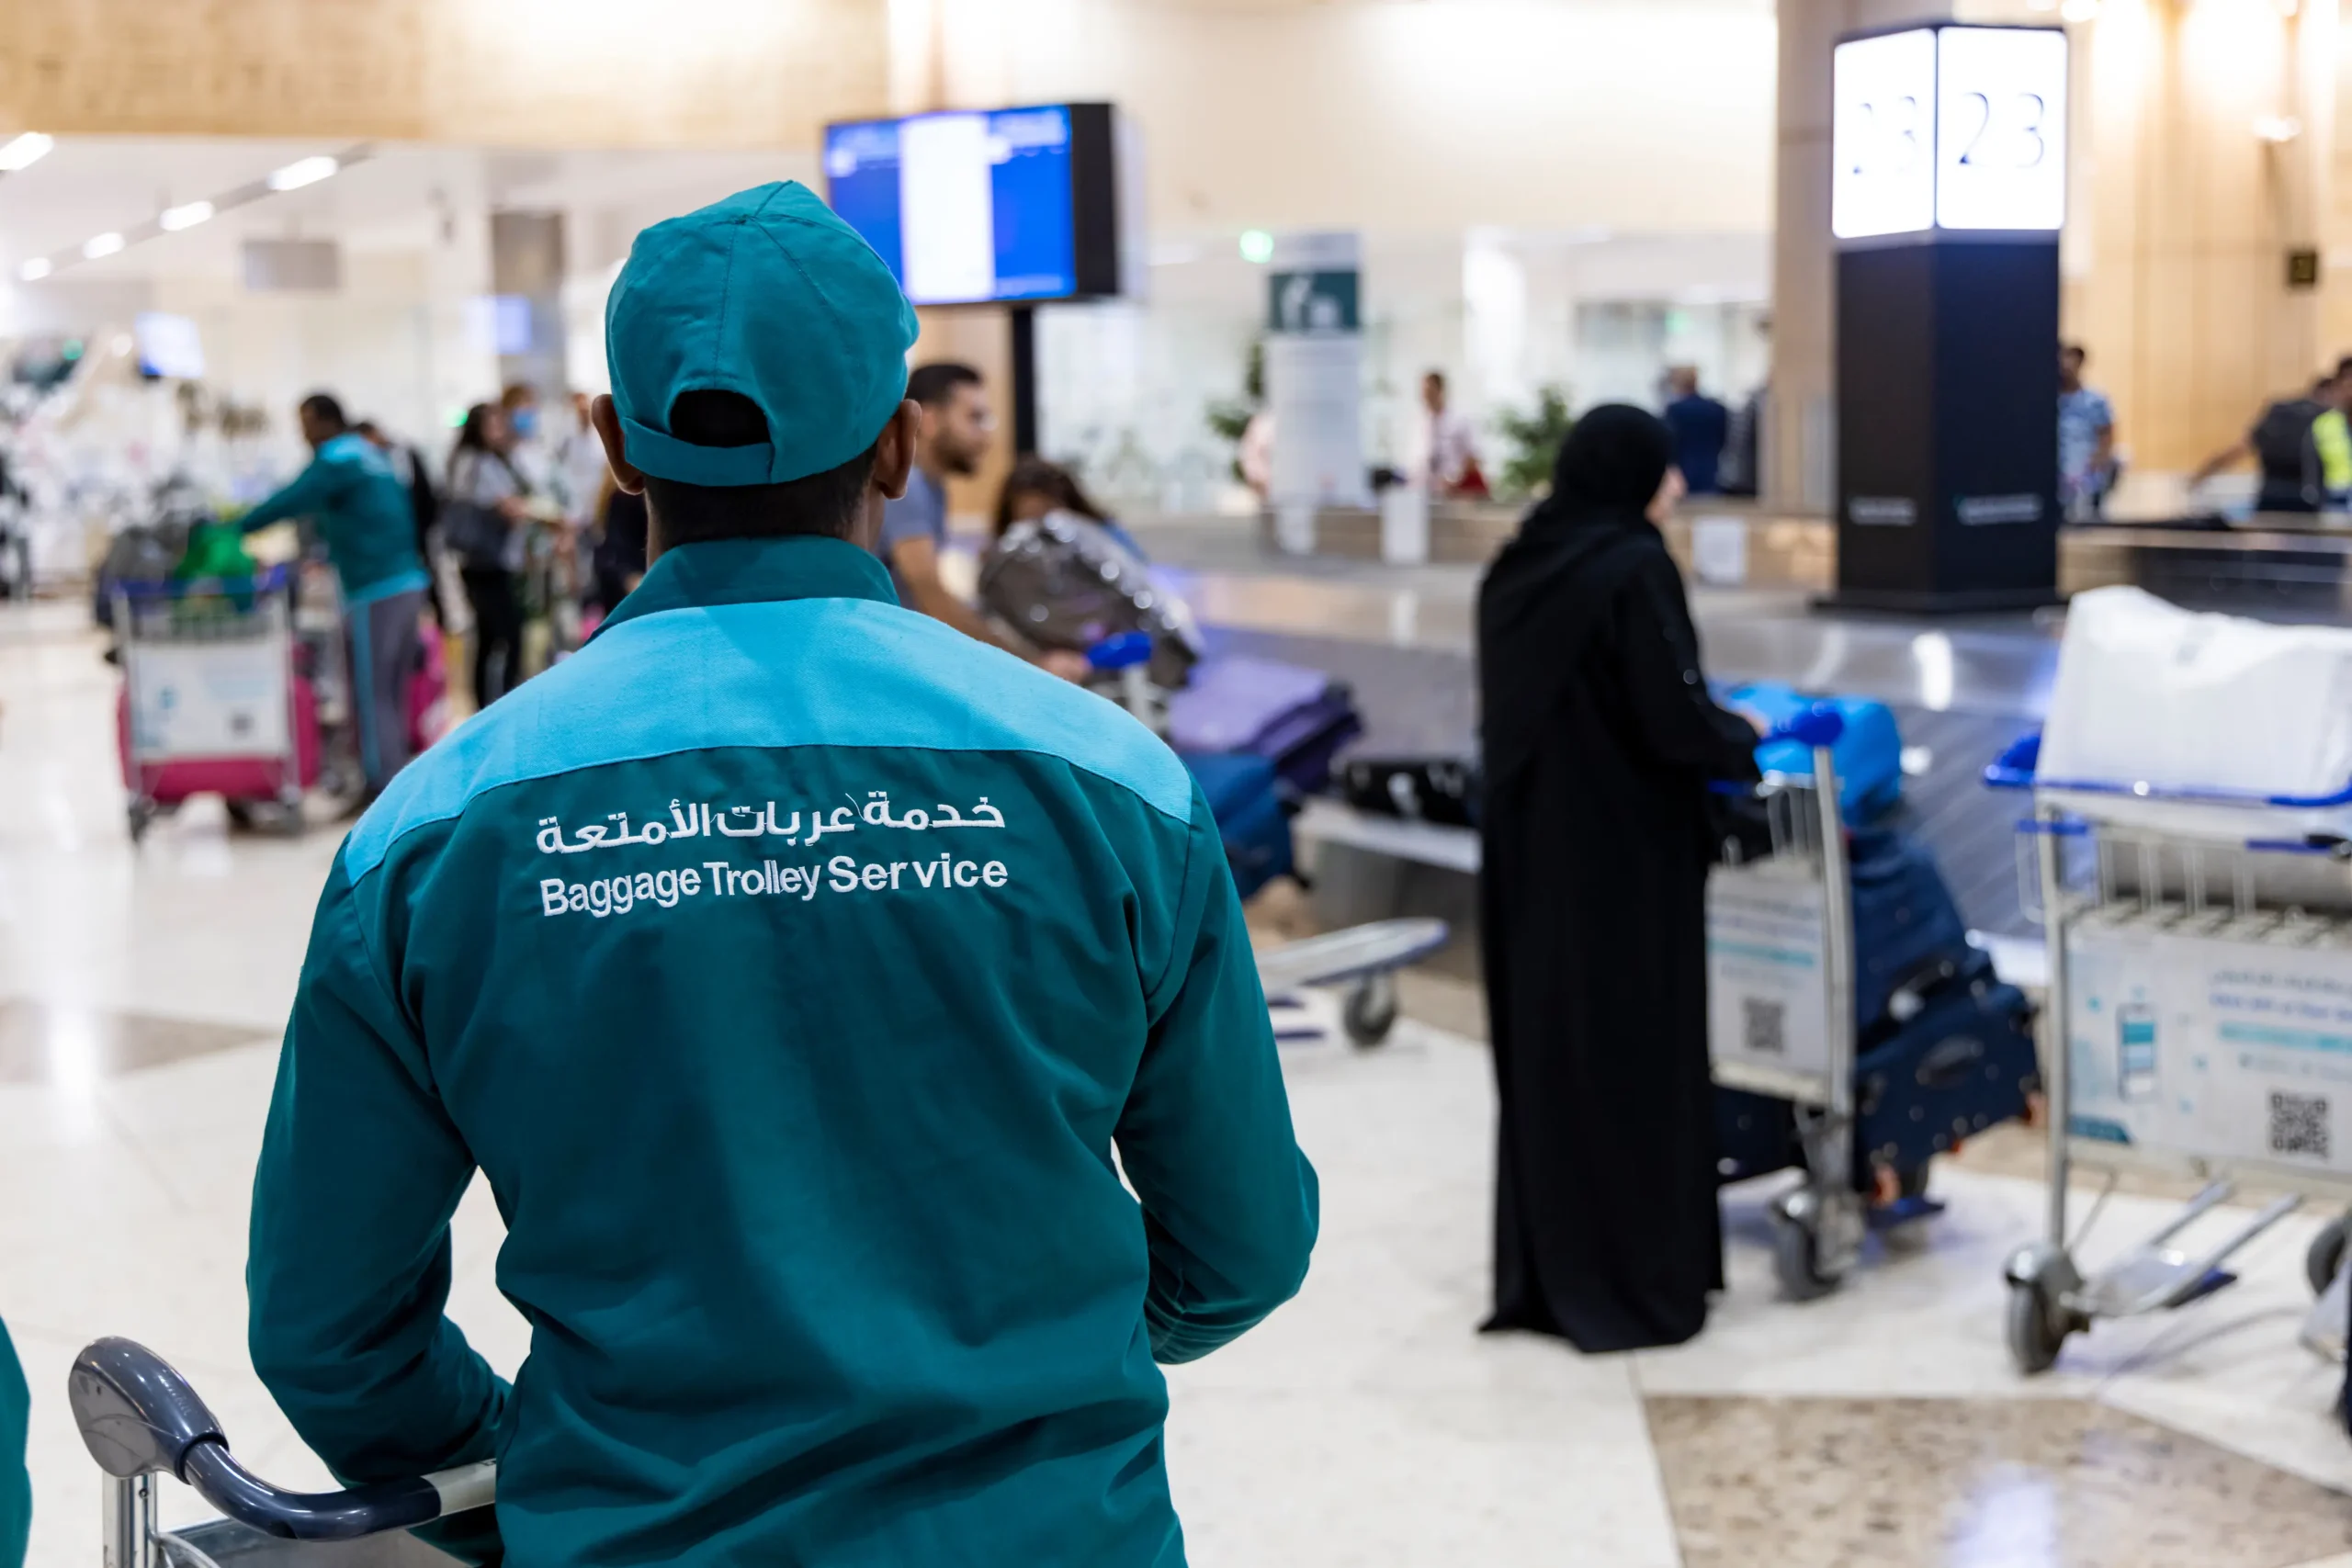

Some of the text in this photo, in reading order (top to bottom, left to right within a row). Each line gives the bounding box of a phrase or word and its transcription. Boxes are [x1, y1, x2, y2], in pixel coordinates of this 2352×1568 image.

[1956, 90, 2046, 169] 23
[536, 790, 1006, 854] خدمة عربات الأمتعة
[539, 852, 1009, 918] Baggage Trolley Service
